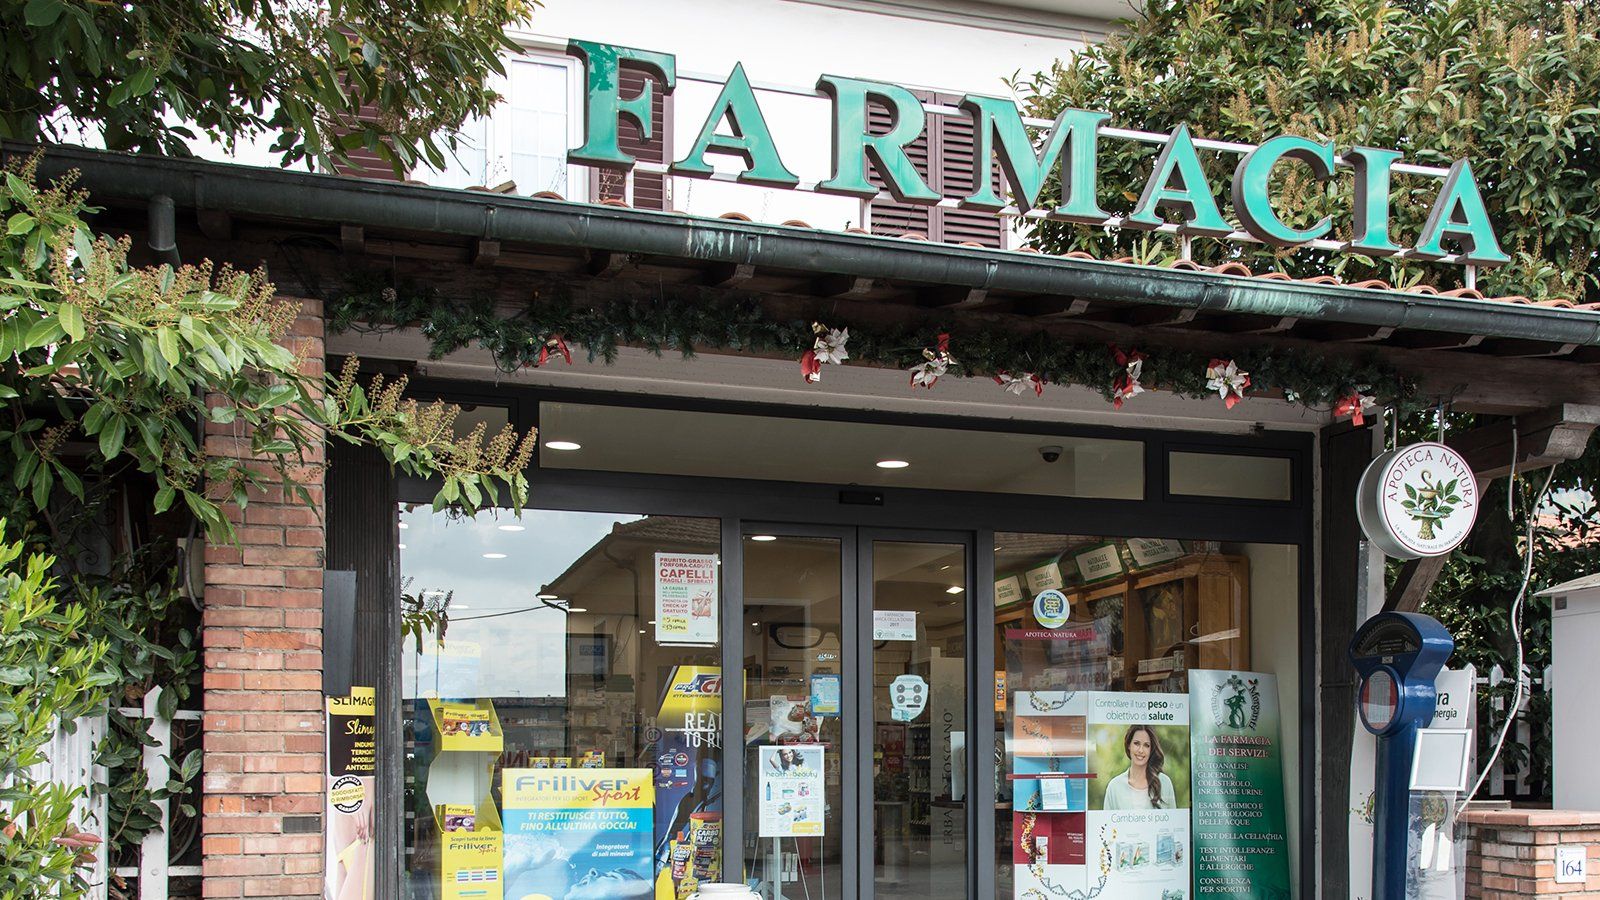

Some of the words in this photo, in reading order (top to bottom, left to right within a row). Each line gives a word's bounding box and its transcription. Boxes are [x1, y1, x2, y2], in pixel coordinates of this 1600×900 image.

[567, 40, 1511, 266] FARMACIA
[1388, 450, 1433, 501] APOTECA
[1440, 453, 1473, 509] NATURA
[660, 569, 714, 579] CAPELLI
[1435, 692, 1450, 706] ra
[1095, 699, 1129, 709] Controllare
[1134, 700, 1147, 709] tuo
[1147, 700, 1168, 712] peso
[1106, 711, 1140, 721] obiettivo
[1140, 711, 1147, 721] di
[1148, 711, 1174, 721] salute
[684, 732, 701, 747] TO
[1204, 735, 1218, 744] LA
[1221, 736, 1271, 745] FARMACIA
[1209, 748, 1226, 756] DEI
[516, 776, 629, 791] Friliver
[592, 783, 641, 806] Sport
[1226, 802, 1257, 810] CHIMICO
[528, 812, 536, 820] TI
[536, 812, 595, 820] RESTITUISCE
[596, 812, 630, 821] TUTTO,
[1199, 810, 1263, 818] BATTERIOLOGICO
[1111, 813, 1146, 823] Cambiare
[1155, 813, 1170, 826] può
[1224, 819, 1251, 827] ACQUE
[520, 822, 544, 831] FINO
[544, 822, 598, 831] ALL'ULTIMA
[599, 821, 637, 830] GOCCIA!
[1244, 833, 1284, 841] CELIACHIA
[478, 846, 498, 855] Sport
[1219, 847, 1275, 855] INTOLLERANZE
[1206, 863, 1254, 871] ALLERGICHE
[1562, 859, 1582, 877] 164
[1199, 877, 1252, 885] CONSULENZA
